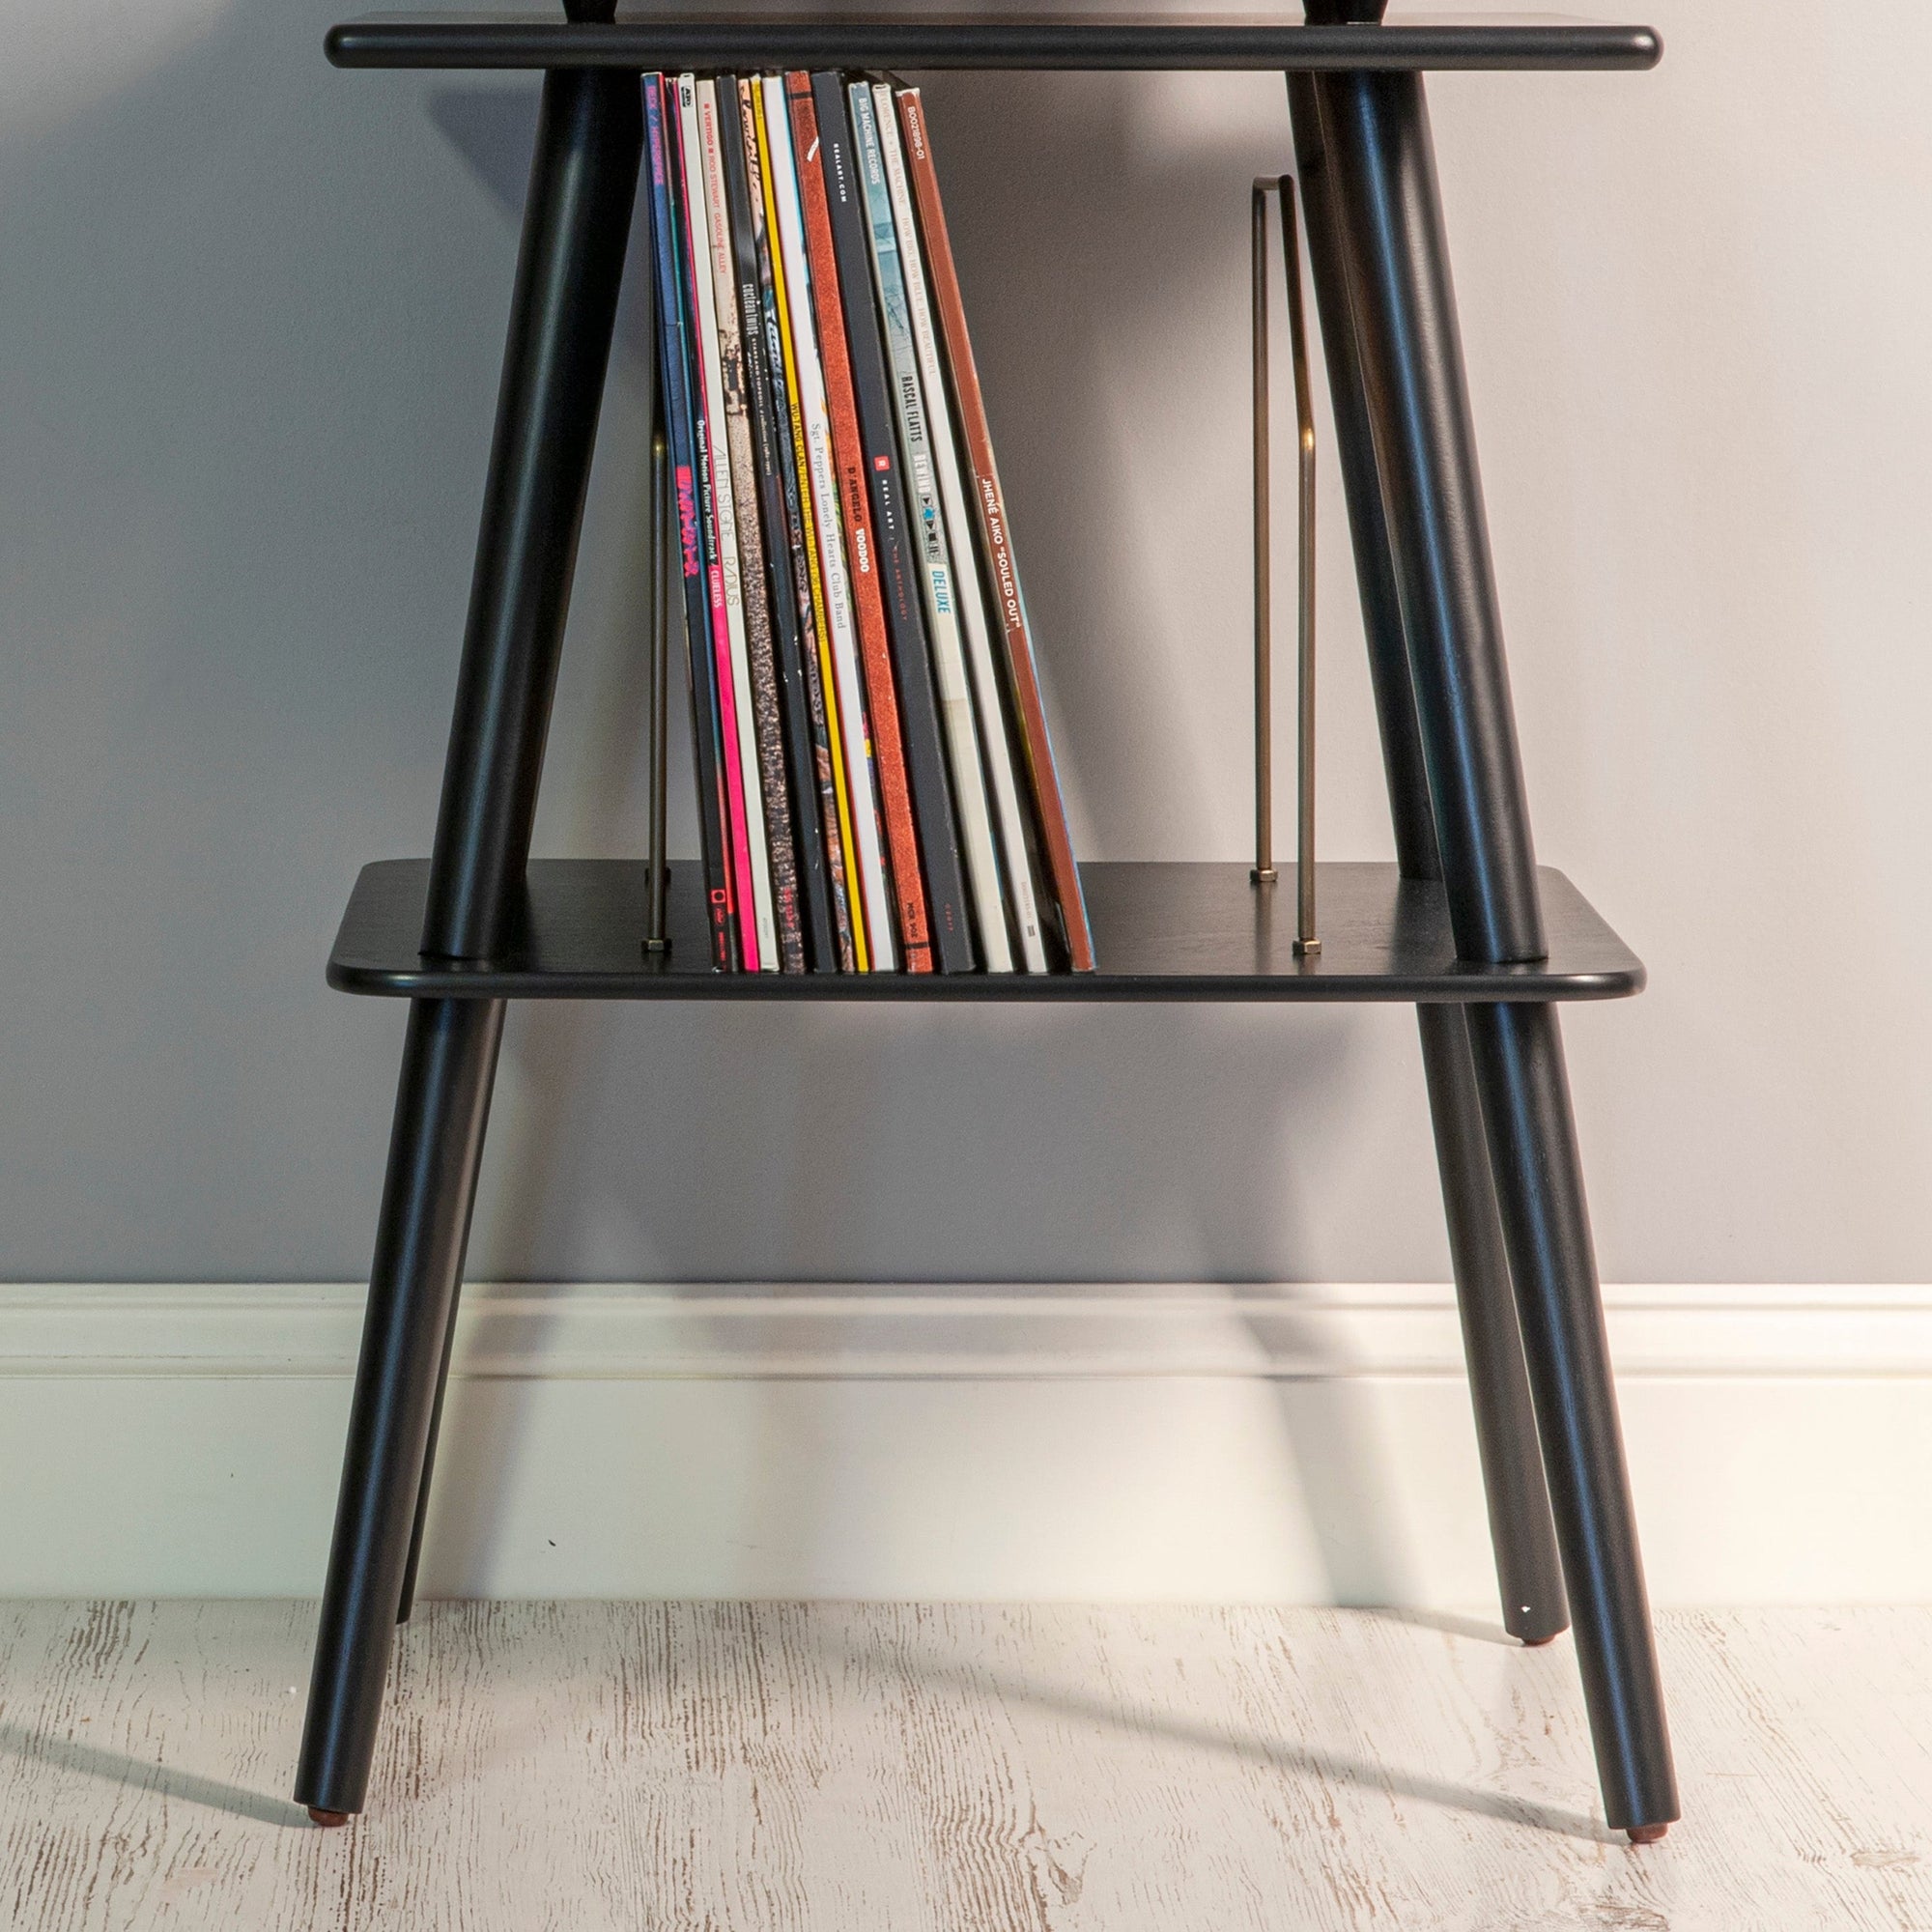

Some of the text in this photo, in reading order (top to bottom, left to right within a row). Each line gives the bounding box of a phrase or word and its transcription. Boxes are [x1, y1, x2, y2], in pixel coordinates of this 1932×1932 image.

[648, 85, 657, 110] BECK
[878, 91, 894, 137] FLORENCE
[704, 111, 713, 146] VERTIGO
[857, 97, 880, 185] BIG MACHINE RECORDS
[650, 125, 664, 185] HYPERSPACE
[832, 143, 846, 202] REALART.COM
[710, 174, 720, 208] STEWART
[892, 167, 906, 205] MACHINE
[714, 212, 724, 250] GASOLINE
[900, 217, 912, 240] HOW
[908, 259, 919, 279] HOW
[917, 307, 927, 327] HOW
[921, 329, 936, 376] BEAUTIFUL
[899, 375, 923, 442] RASCAL FLATTS
[696, 419, 707, 452] Original
[699, 454, 710, 482] Motion
[791, 403, 802, 441] WU-TANG
[805, 526, 817, 569] WU-TANG
[912, 453, 930, 493] REWIND
[701, 483, 713, 512] Picture
[880, 479, 891, 505] REAL
[981, 477, 998, 514] JHENÉ
[704, 514, 717, 559] Soundtrack
[712, 443, 739, 606] ALLEN STONE RADIUS
[810, 422, 846, 628] Sgt. Peppers Lonely Hearts Club Band
[847, 467, 869, 572] D'ANGELO VOODOO
[885, 511, 895, 530] ART
[988, 516, 1004, 545] AIKO
[710, 570, 722, 608] CLUELESS
[931, 569, 951, 615] DELUXE
